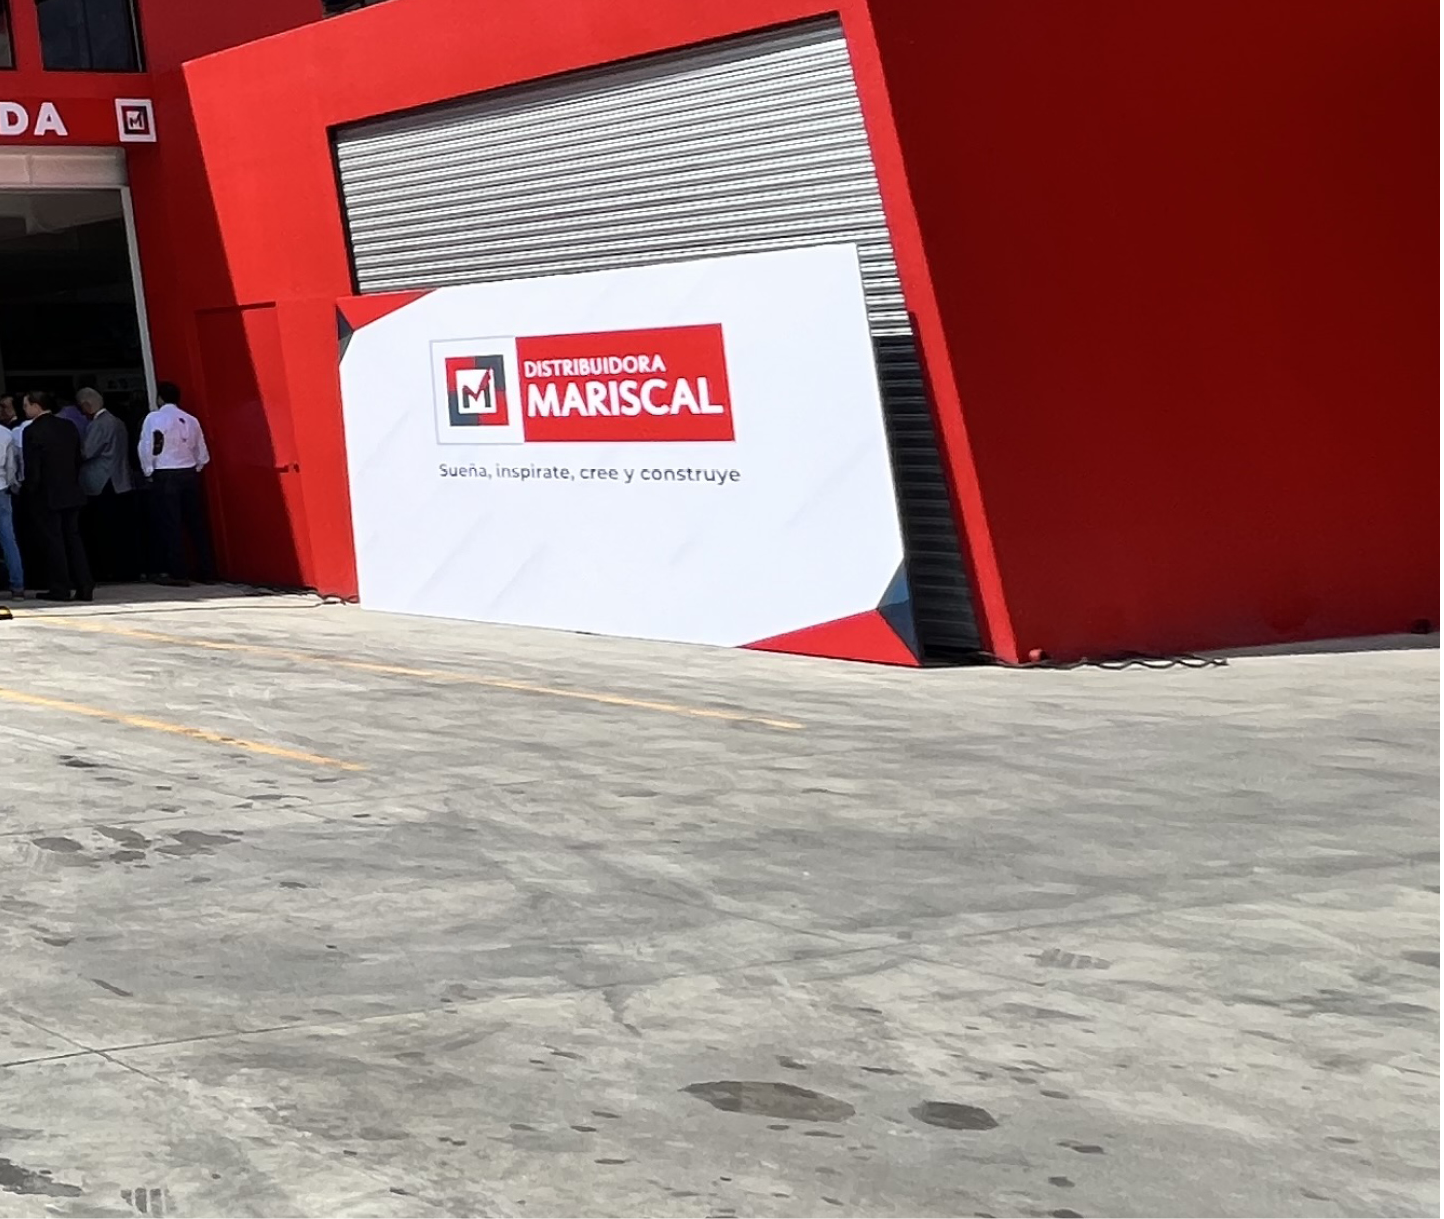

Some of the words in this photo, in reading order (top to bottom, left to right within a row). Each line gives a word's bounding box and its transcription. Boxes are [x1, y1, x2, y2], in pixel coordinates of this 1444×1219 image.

[524, 354, 667, 379] DISTRIBUIDORA
[527, 376, 725, 417] MARISCAL
[438, 464, 492, 480] Sueña,
[580, 467, 619, 481] cree
[623, 467, 636, 484] y
[641, 466, 741, 485] construye
